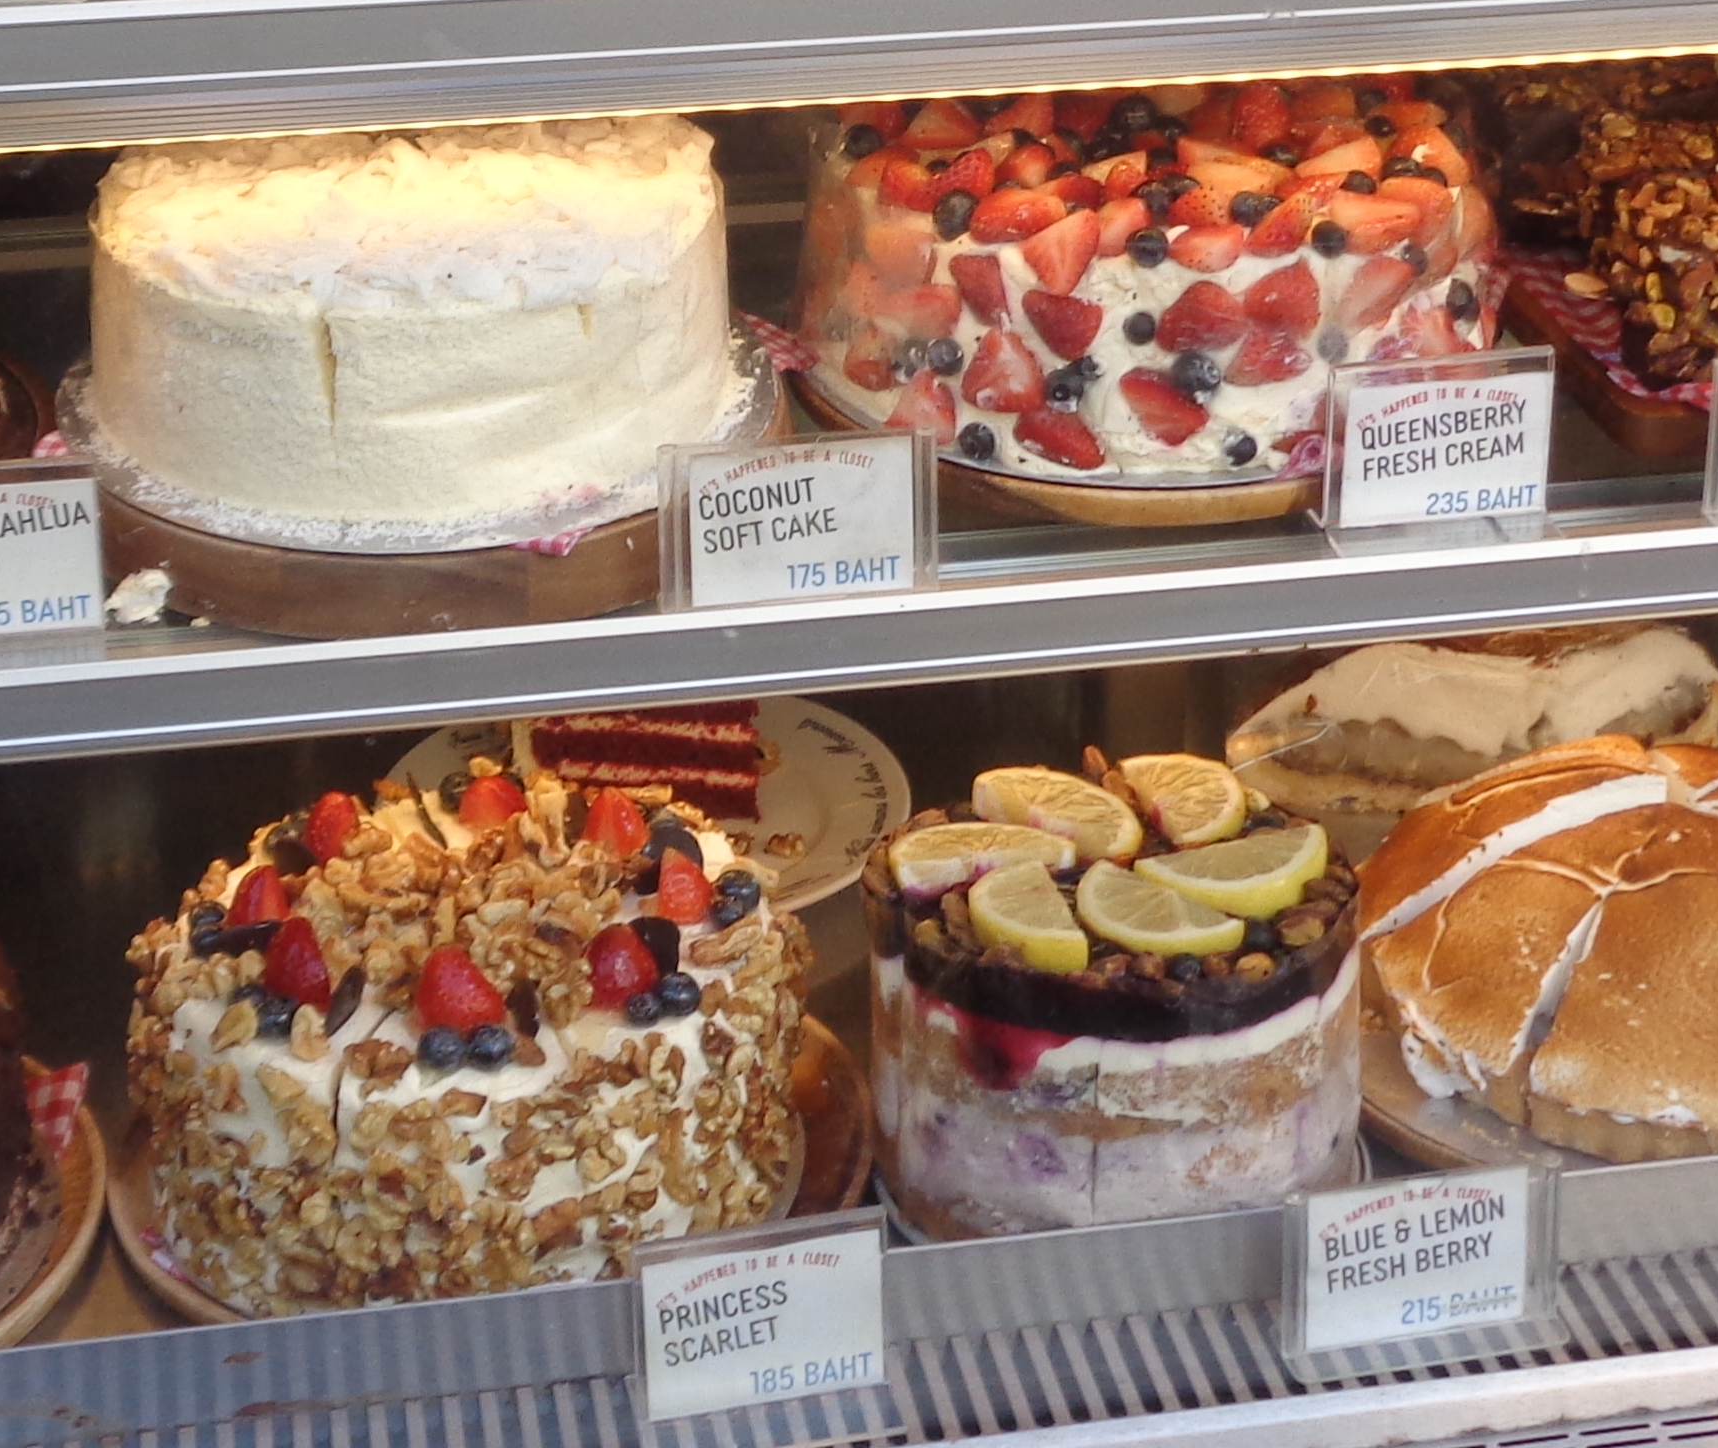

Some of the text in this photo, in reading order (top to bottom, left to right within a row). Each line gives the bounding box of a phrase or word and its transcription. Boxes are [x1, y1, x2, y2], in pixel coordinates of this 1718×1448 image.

[1361, 399, 1526, 450] QUEENSBERRY
[1363, 432, 1524, 481] FRESH CREAM
[699, 477, 815, 521] COCONUT
[1426, 484, 1538, 515] 235 BAHT
[703, 508, 838, 554] SOFT CAKE
[787, 556, 900, 589] 175 BAHT
[21, 595, 90, 624] BAHT
[1326, 1195, 1504, 1262] BLUE & LEMON
[1327, 1232, 1492, 1294] FRESH BERRY
[660, 1281, 788, 1334] PRINCESS
[1401, 1296, 1441, 1324] 215
[665, 1316, 778, 1367] SCARLET
[750, 1352, 872, 1395] 185 BAHT
